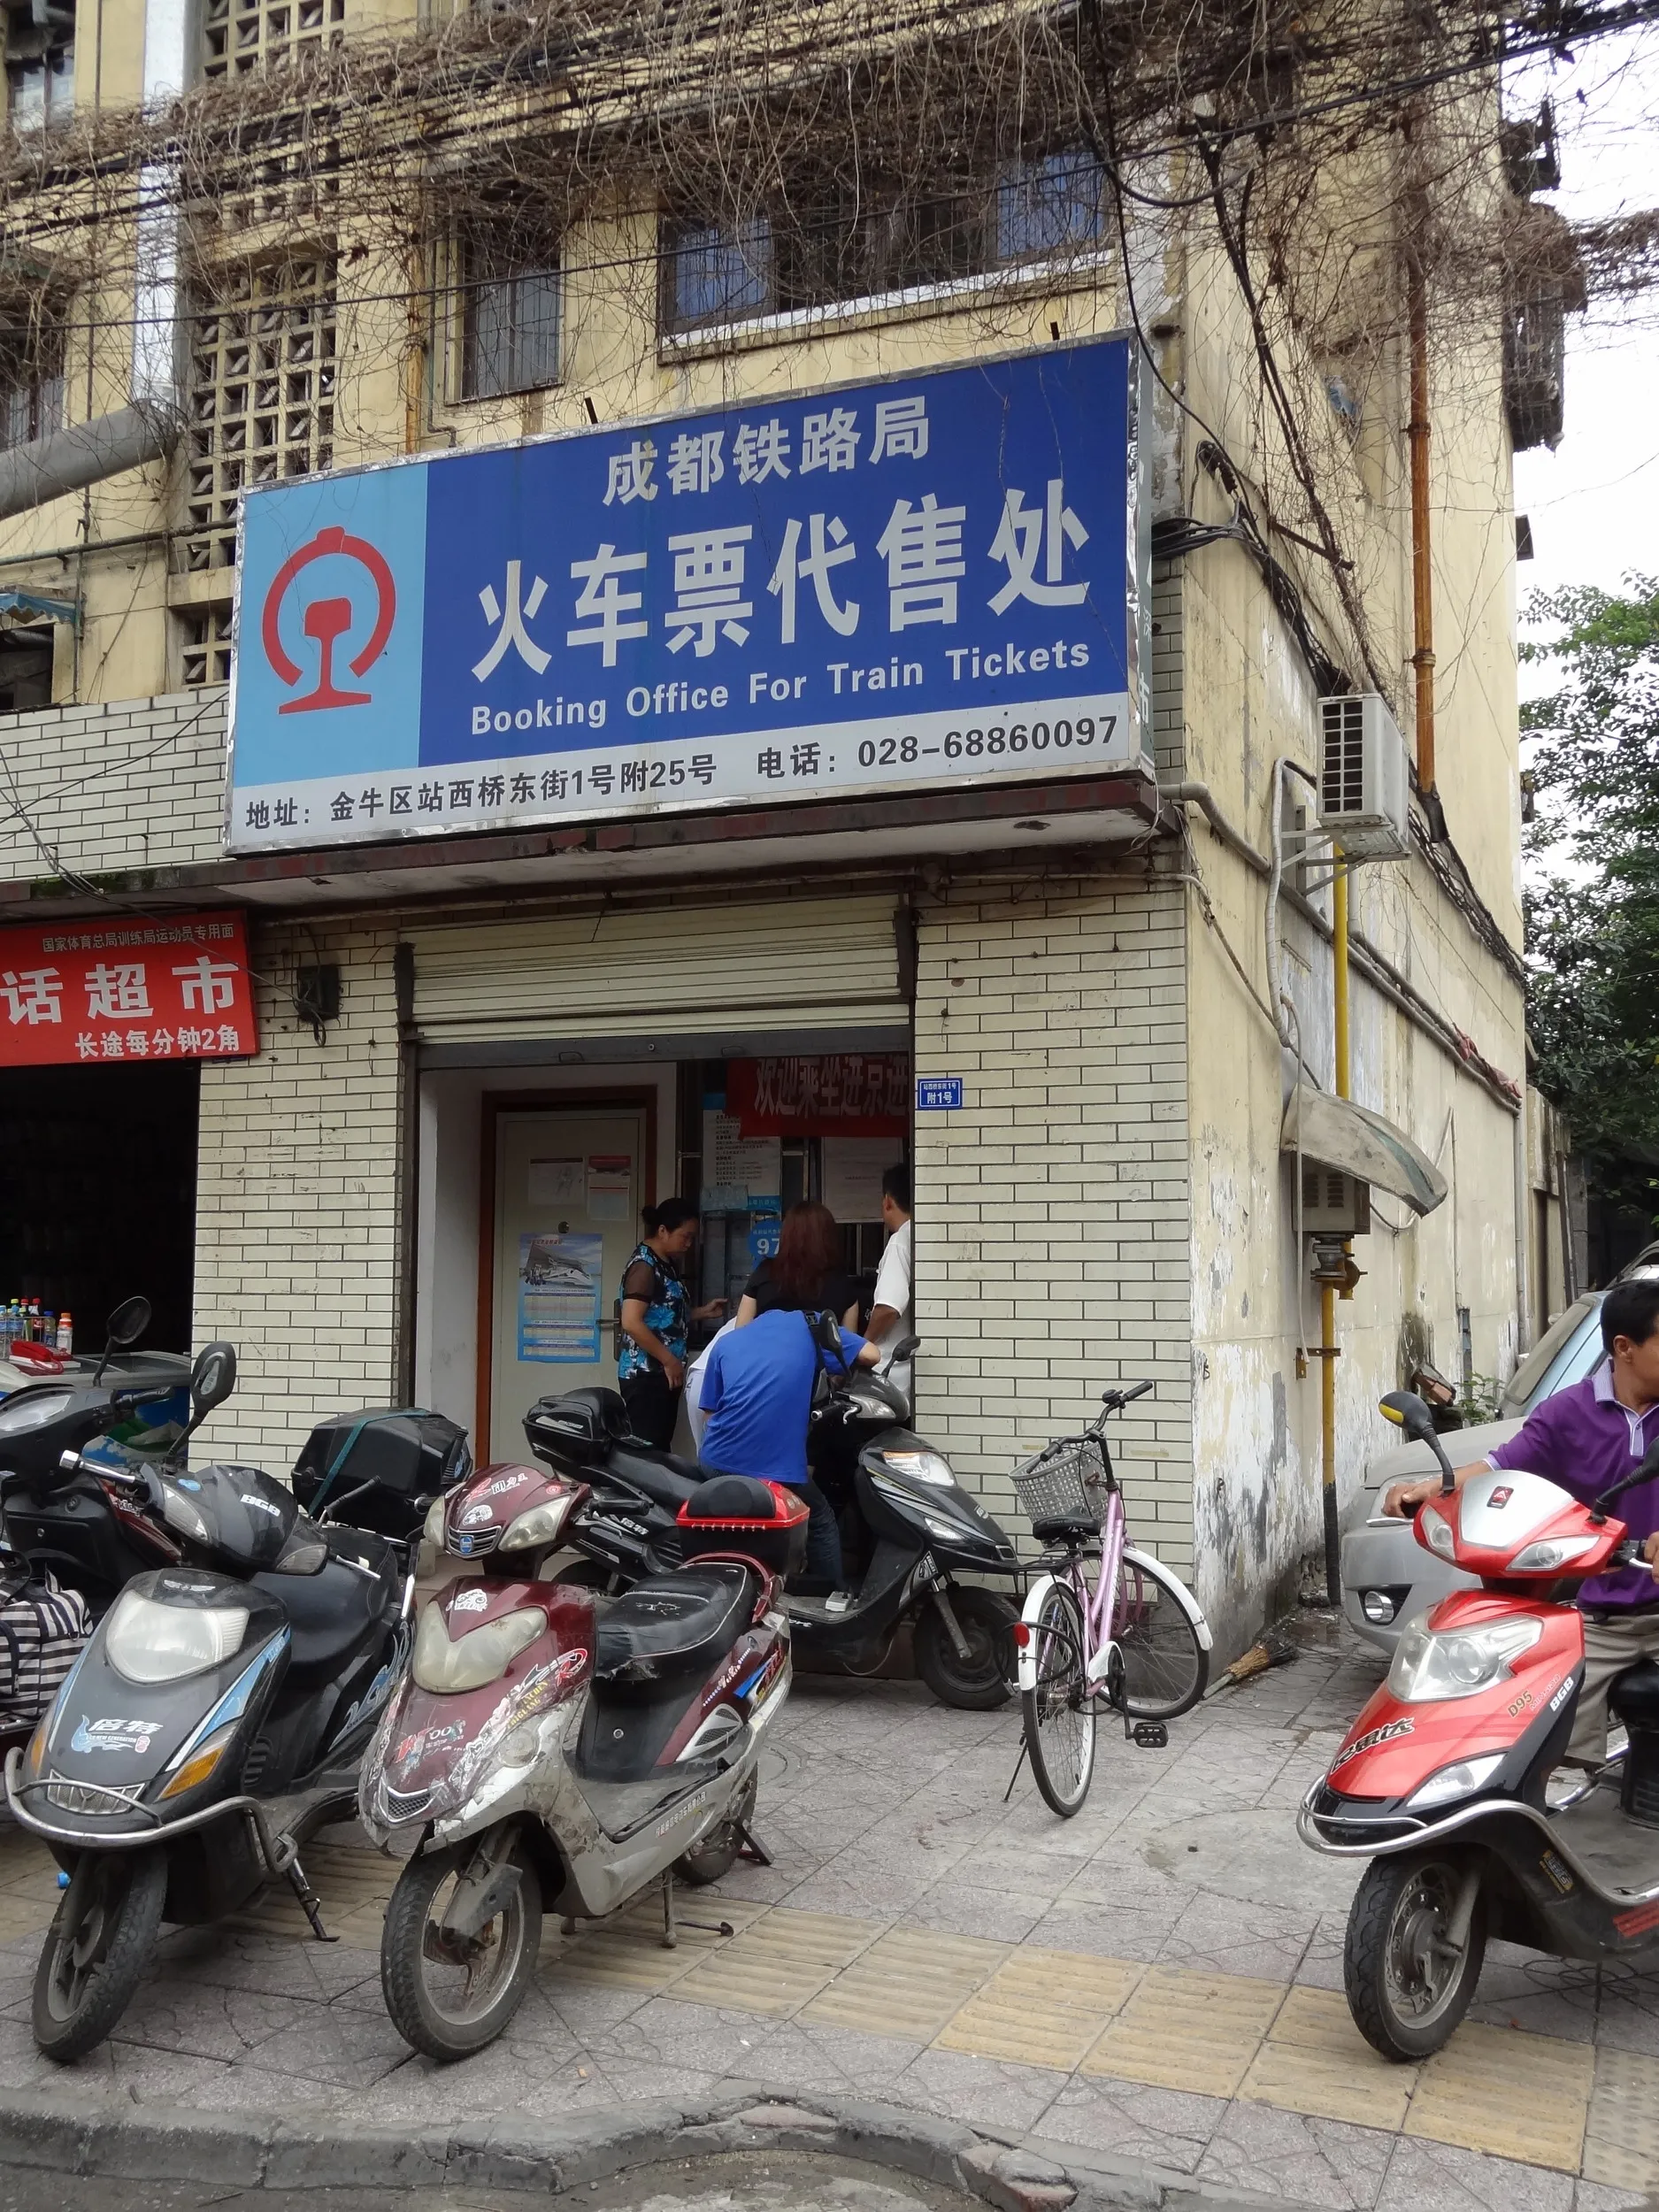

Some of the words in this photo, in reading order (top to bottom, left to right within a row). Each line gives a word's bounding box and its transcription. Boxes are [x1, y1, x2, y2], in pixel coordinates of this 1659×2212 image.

[602, 396, 929, 506] 成都铁路局
[471, 479, 1090, 682] 火车票代售处
[472, 696, 606, 735] Booking
[626, 681, 728, 717] Office
[749, 672, 807, 703] For
[827, 657, 922, 694] Train
[946, 640, 1089, 680] Tickets
[75, 1024, 239, 1059] 长途每分钟2角
[926, 1091, 953, 1104] 附1号
[240, 1494, 281, 1517] BGB
[1507, 1690, 1532, 1718] D95
[1549, 1676, 1574, 1712] BGB
